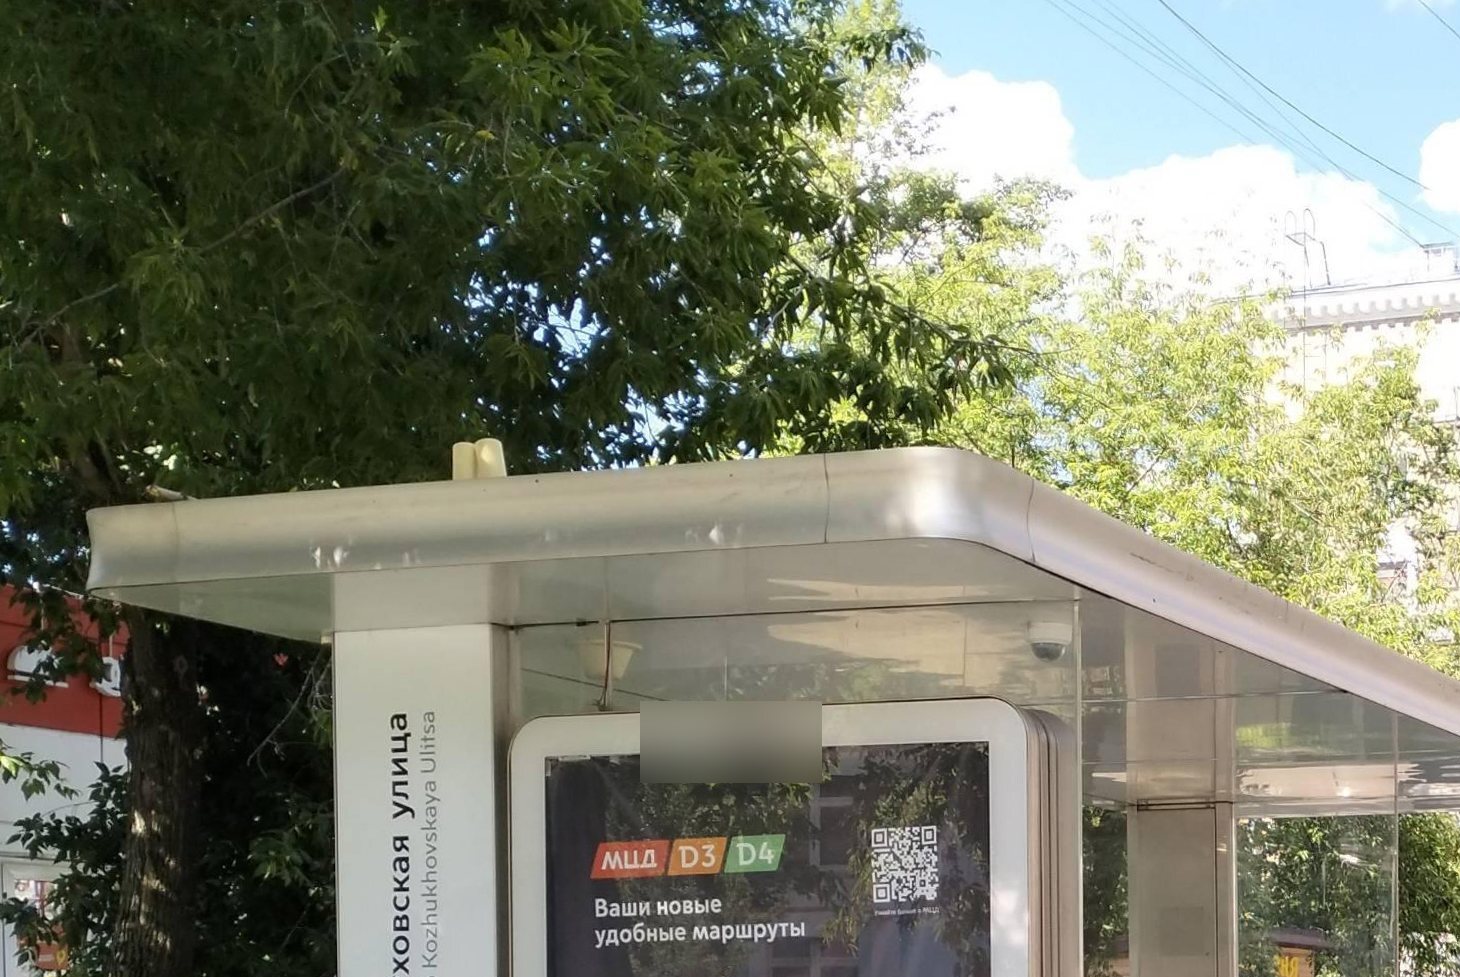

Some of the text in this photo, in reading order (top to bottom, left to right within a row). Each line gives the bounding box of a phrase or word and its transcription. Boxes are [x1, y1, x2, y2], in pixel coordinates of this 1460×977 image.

[419, 711, 437, 774] Ulitsa
[390, 713, 415, 819] улица
[601, 849, 658, 870] МЦД
[678, 845, 716, 868] D3
[735, 841, 774, 866] D4
[420, 780, 441, 968] Kozhukhovskaya
[594, 898, 722, 918] Ваши новые
[594, 921, 806, 949] удобные маршруты
